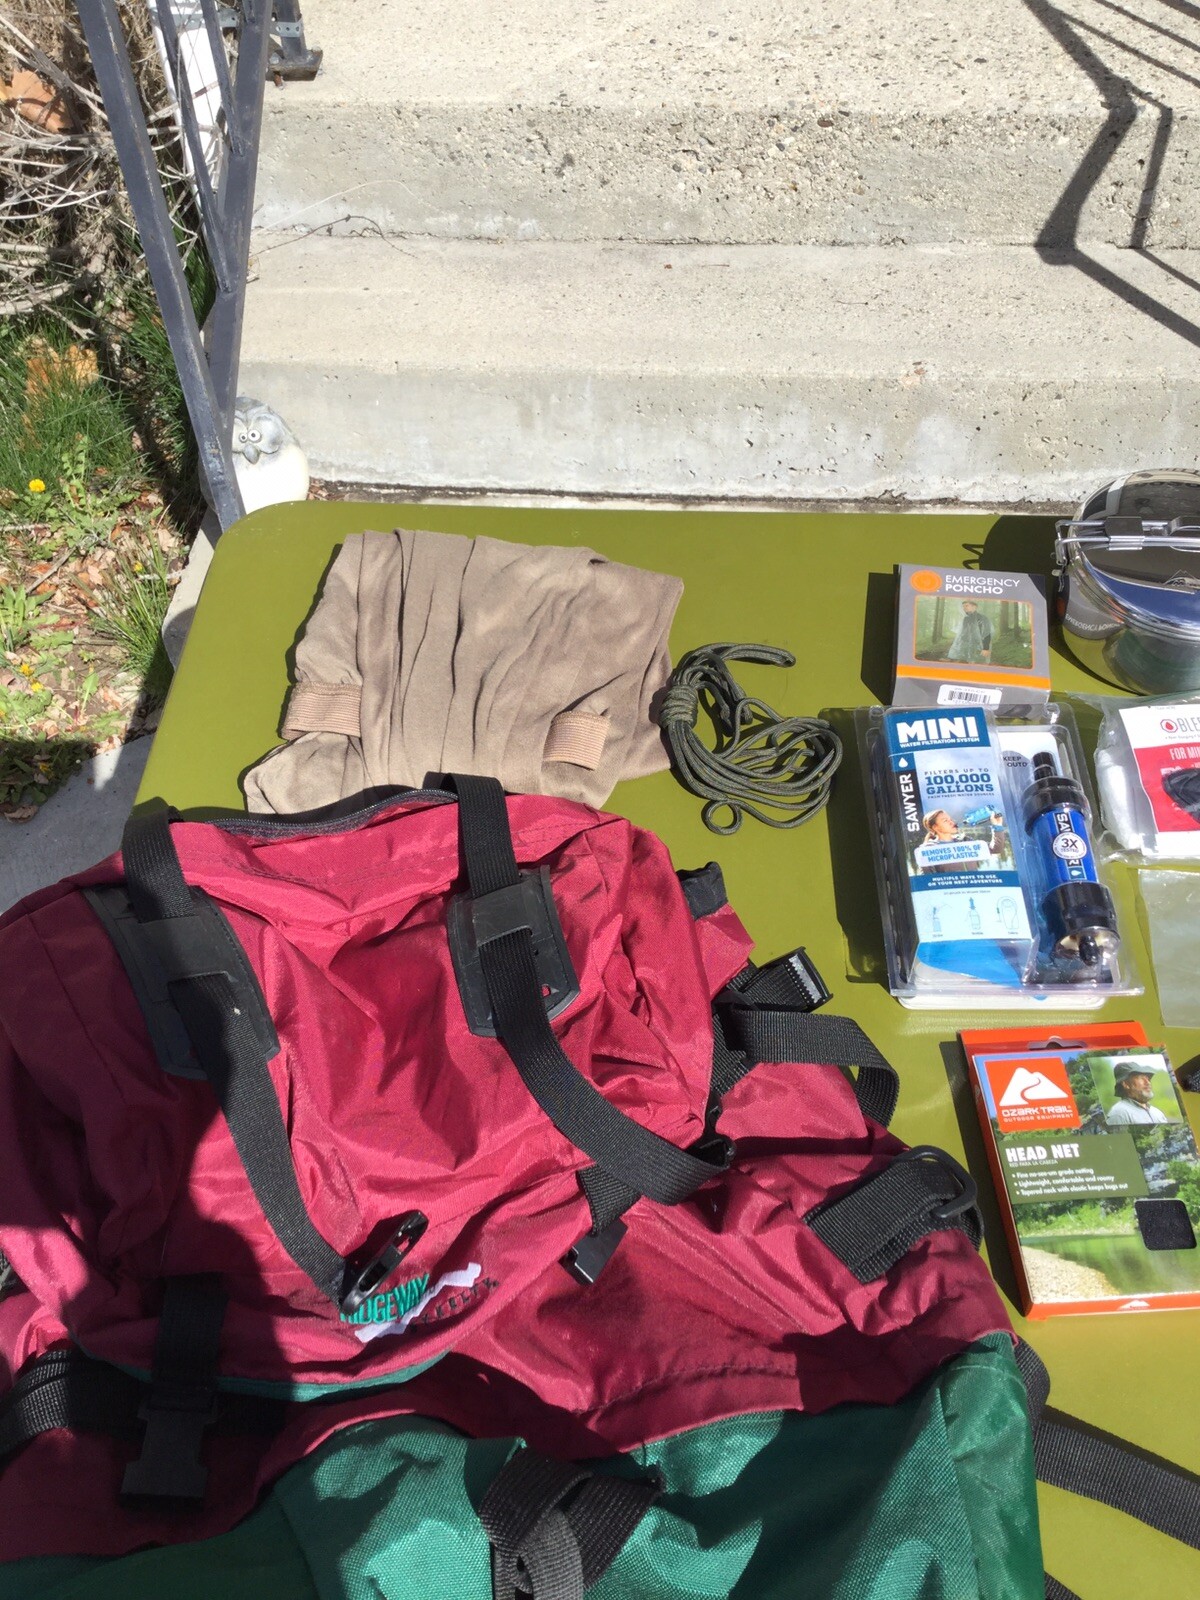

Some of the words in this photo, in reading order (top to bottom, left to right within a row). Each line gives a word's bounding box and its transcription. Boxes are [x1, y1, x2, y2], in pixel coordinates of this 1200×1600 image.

[945, 574, 1020, 587] EMERGENCY
[945, 583, 1003, 595] PONCHO
[896, 716, 979, 744] MINI
[1169, 747, 1187, 760] FOR
[924, 768, 959, 776] FILTERS
[925, 773, 991, 786] 100,000
[926, 783, 994, 795] GALLONS
[899, 773, 920, 832] SAWYER
[1061, 837, 1078, 849] 3X
[921, 847, 951, 857] REMOVES
[953, 845, 972, 853] 100%
[928, 851, 979, 862] MICROPLASTICS
[1001, 1107, 1040, 1117] OZARK
[1040, 1105, 1073, 1114] TRAIL
[1003, 1115, 1035, 1123] OUTDOOR
[1005, 1145, 1047, 1162] HEAD
[1050, 1143, 1080, 1159] NET
[1058, 1168, 1074, 1177] grade
[1075, 1167, 1094, 1175] netting
[1018, 1179, 1052, 1188] Lightweight,
[1052, 1176, 1084, 1185] comfortable
[1020, 1188, 1043, 1196] Tapered
[1043, 1186, 1056, 1194] neck
[1056, 1185, 1070, 1193] with
[1070, 1184, 1087, 1192] elastic
[1087, 1184, 1104, 1192] keeps
[1104, 1183, 1118, 1191] bugs
